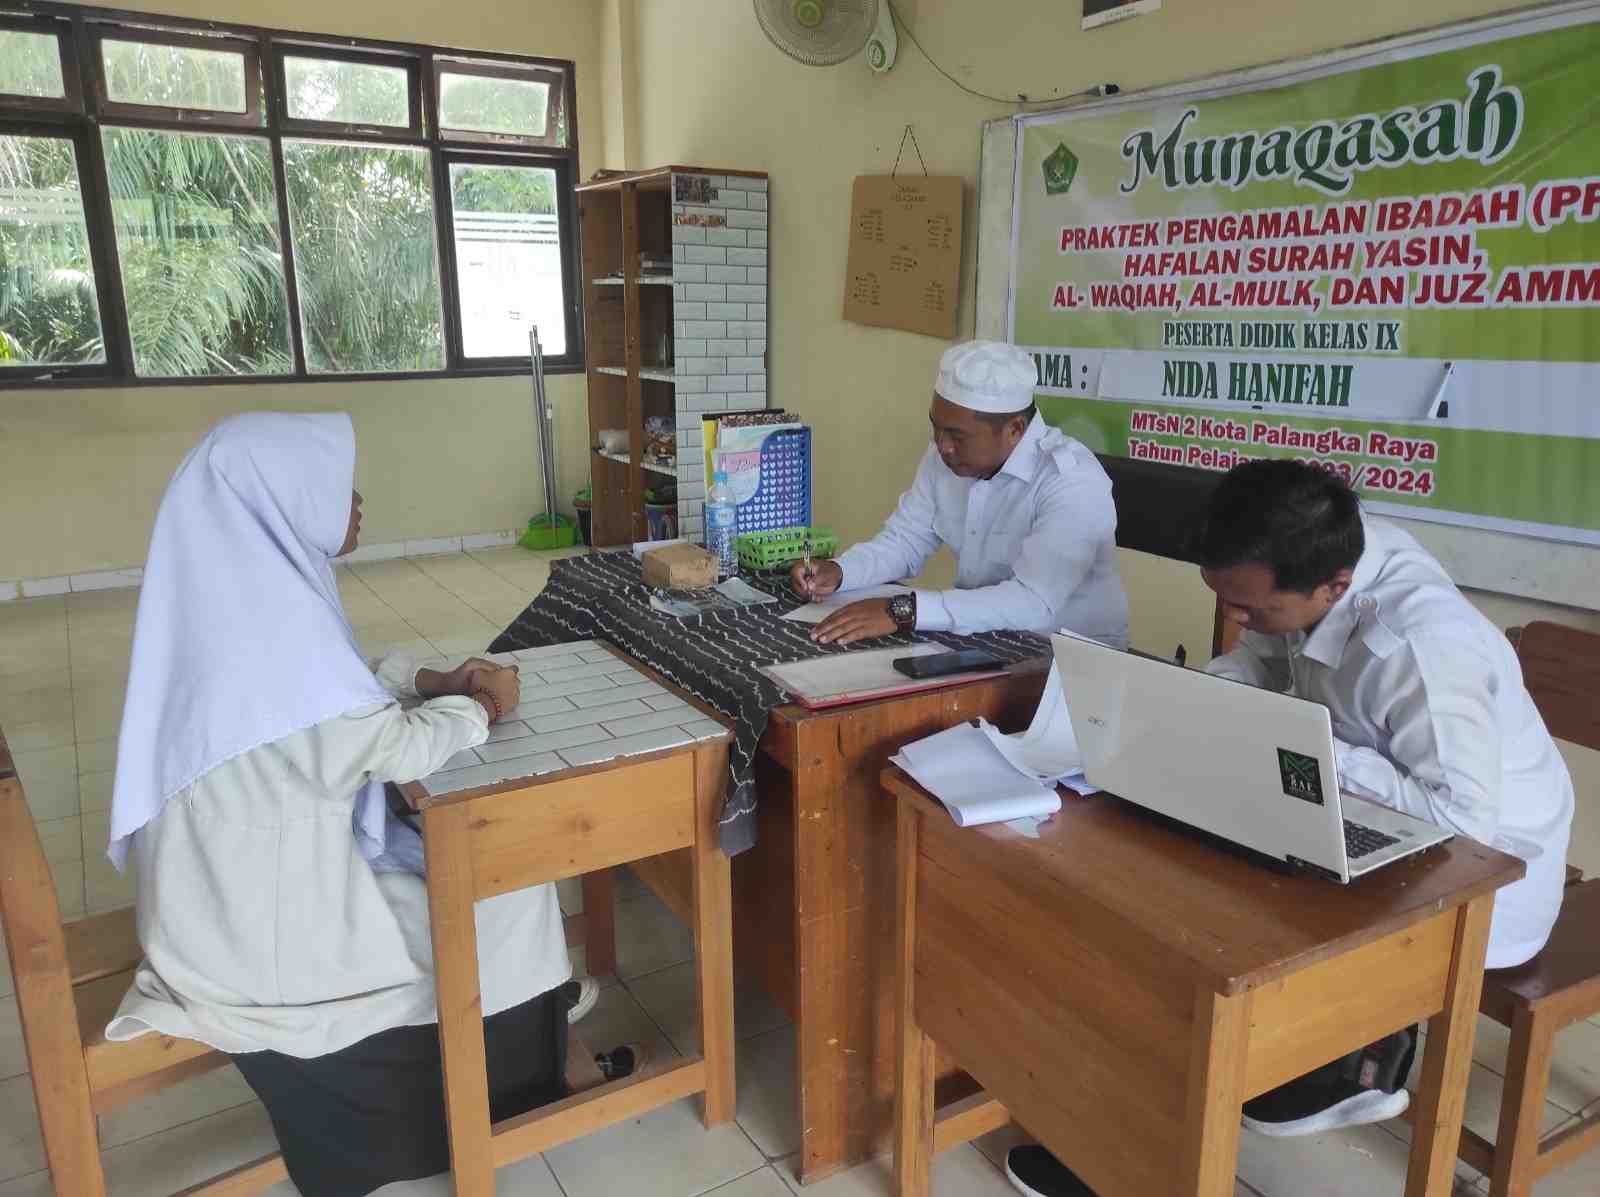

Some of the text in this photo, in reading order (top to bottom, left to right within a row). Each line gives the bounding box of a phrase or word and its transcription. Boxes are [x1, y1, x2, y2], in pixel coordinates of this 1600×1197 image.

[1060, 223, 1159, 250] PRAKTEK
[1168, 206, 1366, 245] PENGAMALAN
[1376, 190, 1520, 231] IBADAH
[1124, 236, 1482, 277] HAFALAN SURAH YASIN,
[1091, 284, 1182, 313] WAQIAH,
[1189, 281, 1320, 312] AL-MULK,
[1331, 277, 1404, 304] DAN
[1415, 273, 1486, 304] JUZ
[1164, 322, 1400, 350] PESERTA DIDIK KELAS IX
[1028, 352, 1073, 388] AMA
[1162, 360, 1219, 399] NIDA
[1228, 363, 1353, 406] HANIFAH
[1130, 440, 1182, 463] Tahun
[1131, 412, 1435, 461] MTsN 2 Kota Palangka Raya
